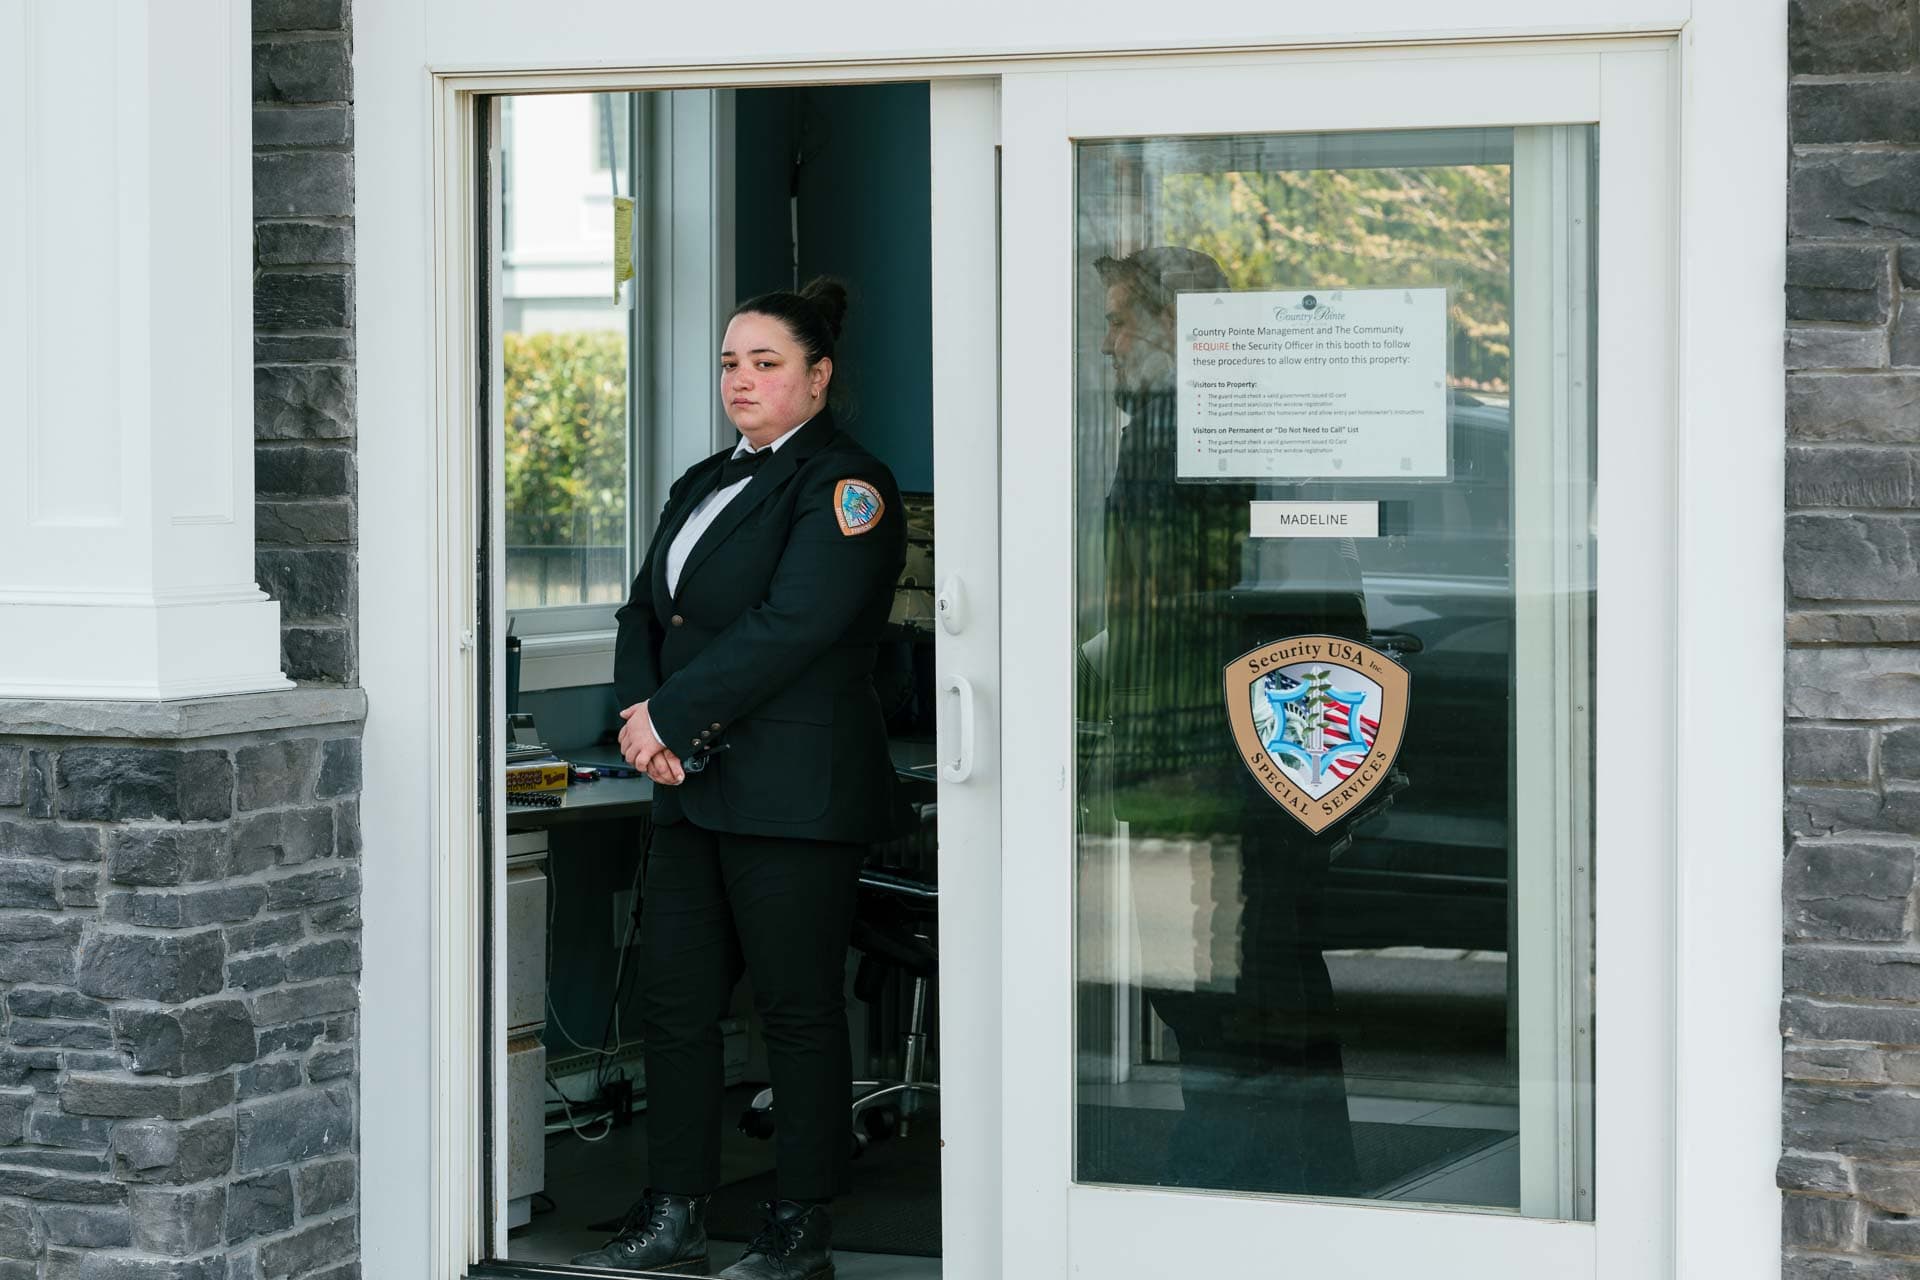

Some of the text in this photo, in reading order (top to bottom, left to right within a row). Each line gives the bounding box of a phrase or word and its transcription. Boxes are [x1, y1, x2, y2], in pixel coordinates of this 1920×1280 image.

[1273, 304, 1346, 321] Country Pointe
[1192, 327, 1226, 338] Country
[1228, 327, 1256, 336] Pointe
[1257, 327, 1314, 337] Management
[1316, 326, 1333, 335] and
[1335, 325, 1351, 334] The
[1353, 325, 1404, 335] Community
[1192, 339, 1411, 352] REQUIRE the Security Officer in this booth to follow
[1192, 355, 1410, 367] these procedures to allow entry onto this property:
[1192, 380, 1217, 389] Visitors
[1226, 380, 1258, 390] Property:
[1192, 426, 1217, 434] Visitors
[1228, 426, 1264, 434] Permanent
[1288, 426, 1301, 434] Not
[1302, 426, 1320, 434] Need
[1280, 514, 1348, 525] MADELINE
[1248, 641, 1384, 674] Security USA Inc.
[1251, 750, 1387, 816] SPECIAL SERVICES
